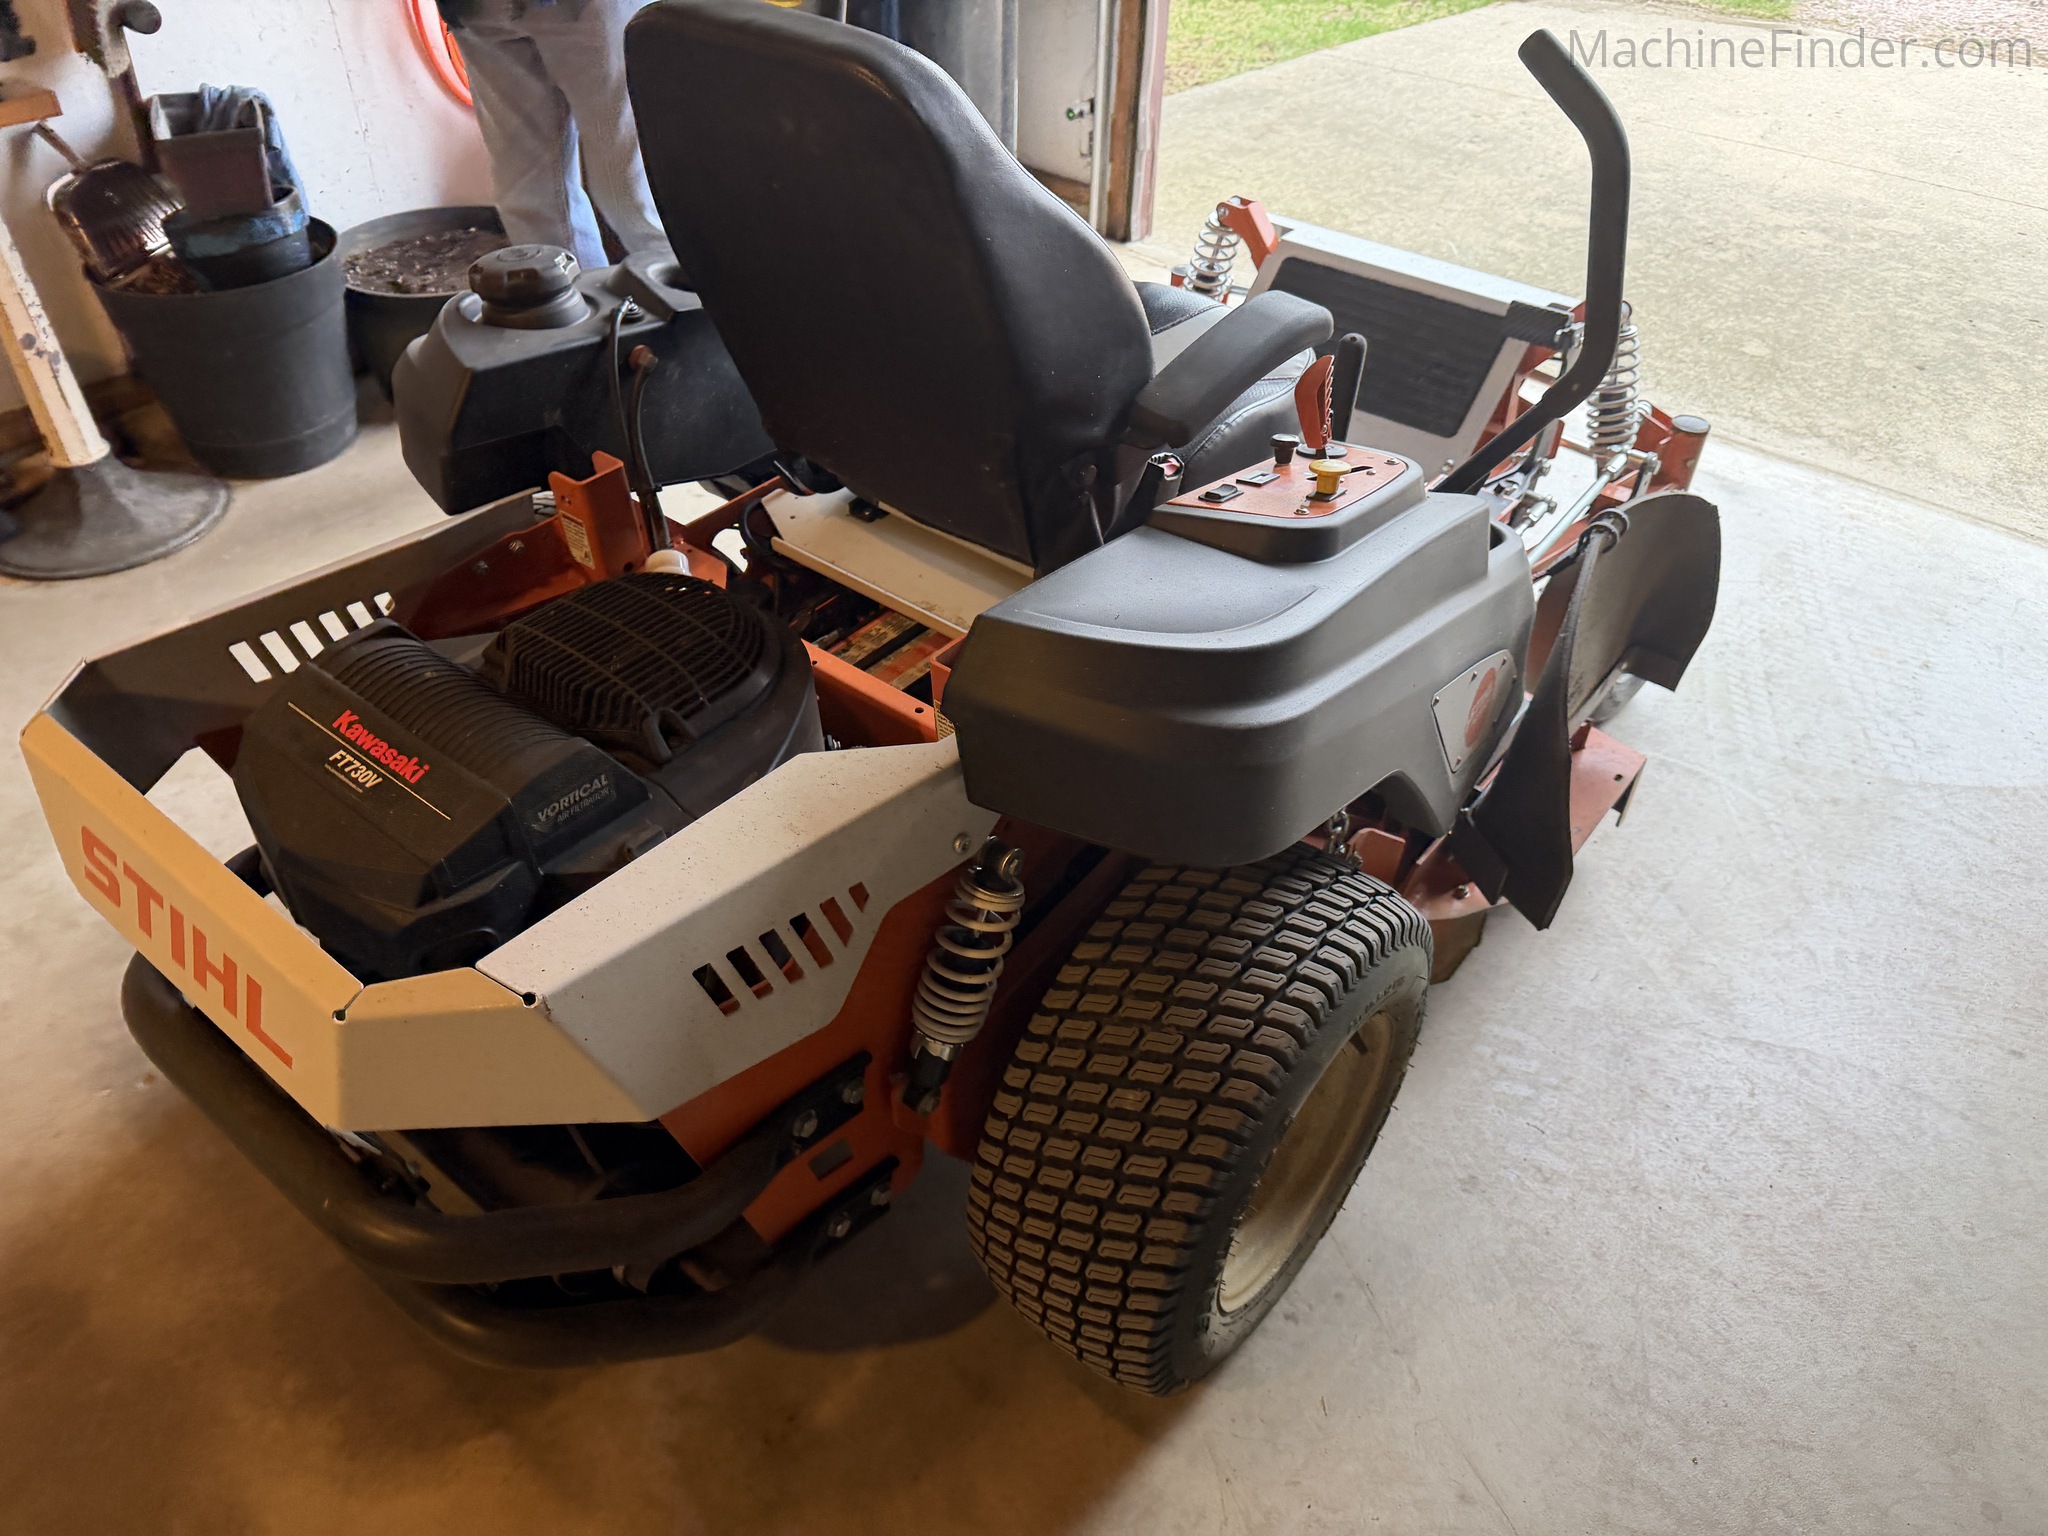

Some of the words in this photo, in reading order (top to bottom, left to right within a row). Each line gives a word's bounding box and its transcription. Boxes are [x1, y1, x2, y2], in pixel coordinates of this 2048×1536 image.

[329, 749, 383, 788] FT730V
[331, 709, 430, 787] Kawasaki
[538, 774, 608, 822] VORTICAL
[558, 810, 570, 822] AIR
[81, 826, 293, 1070] STIHL
